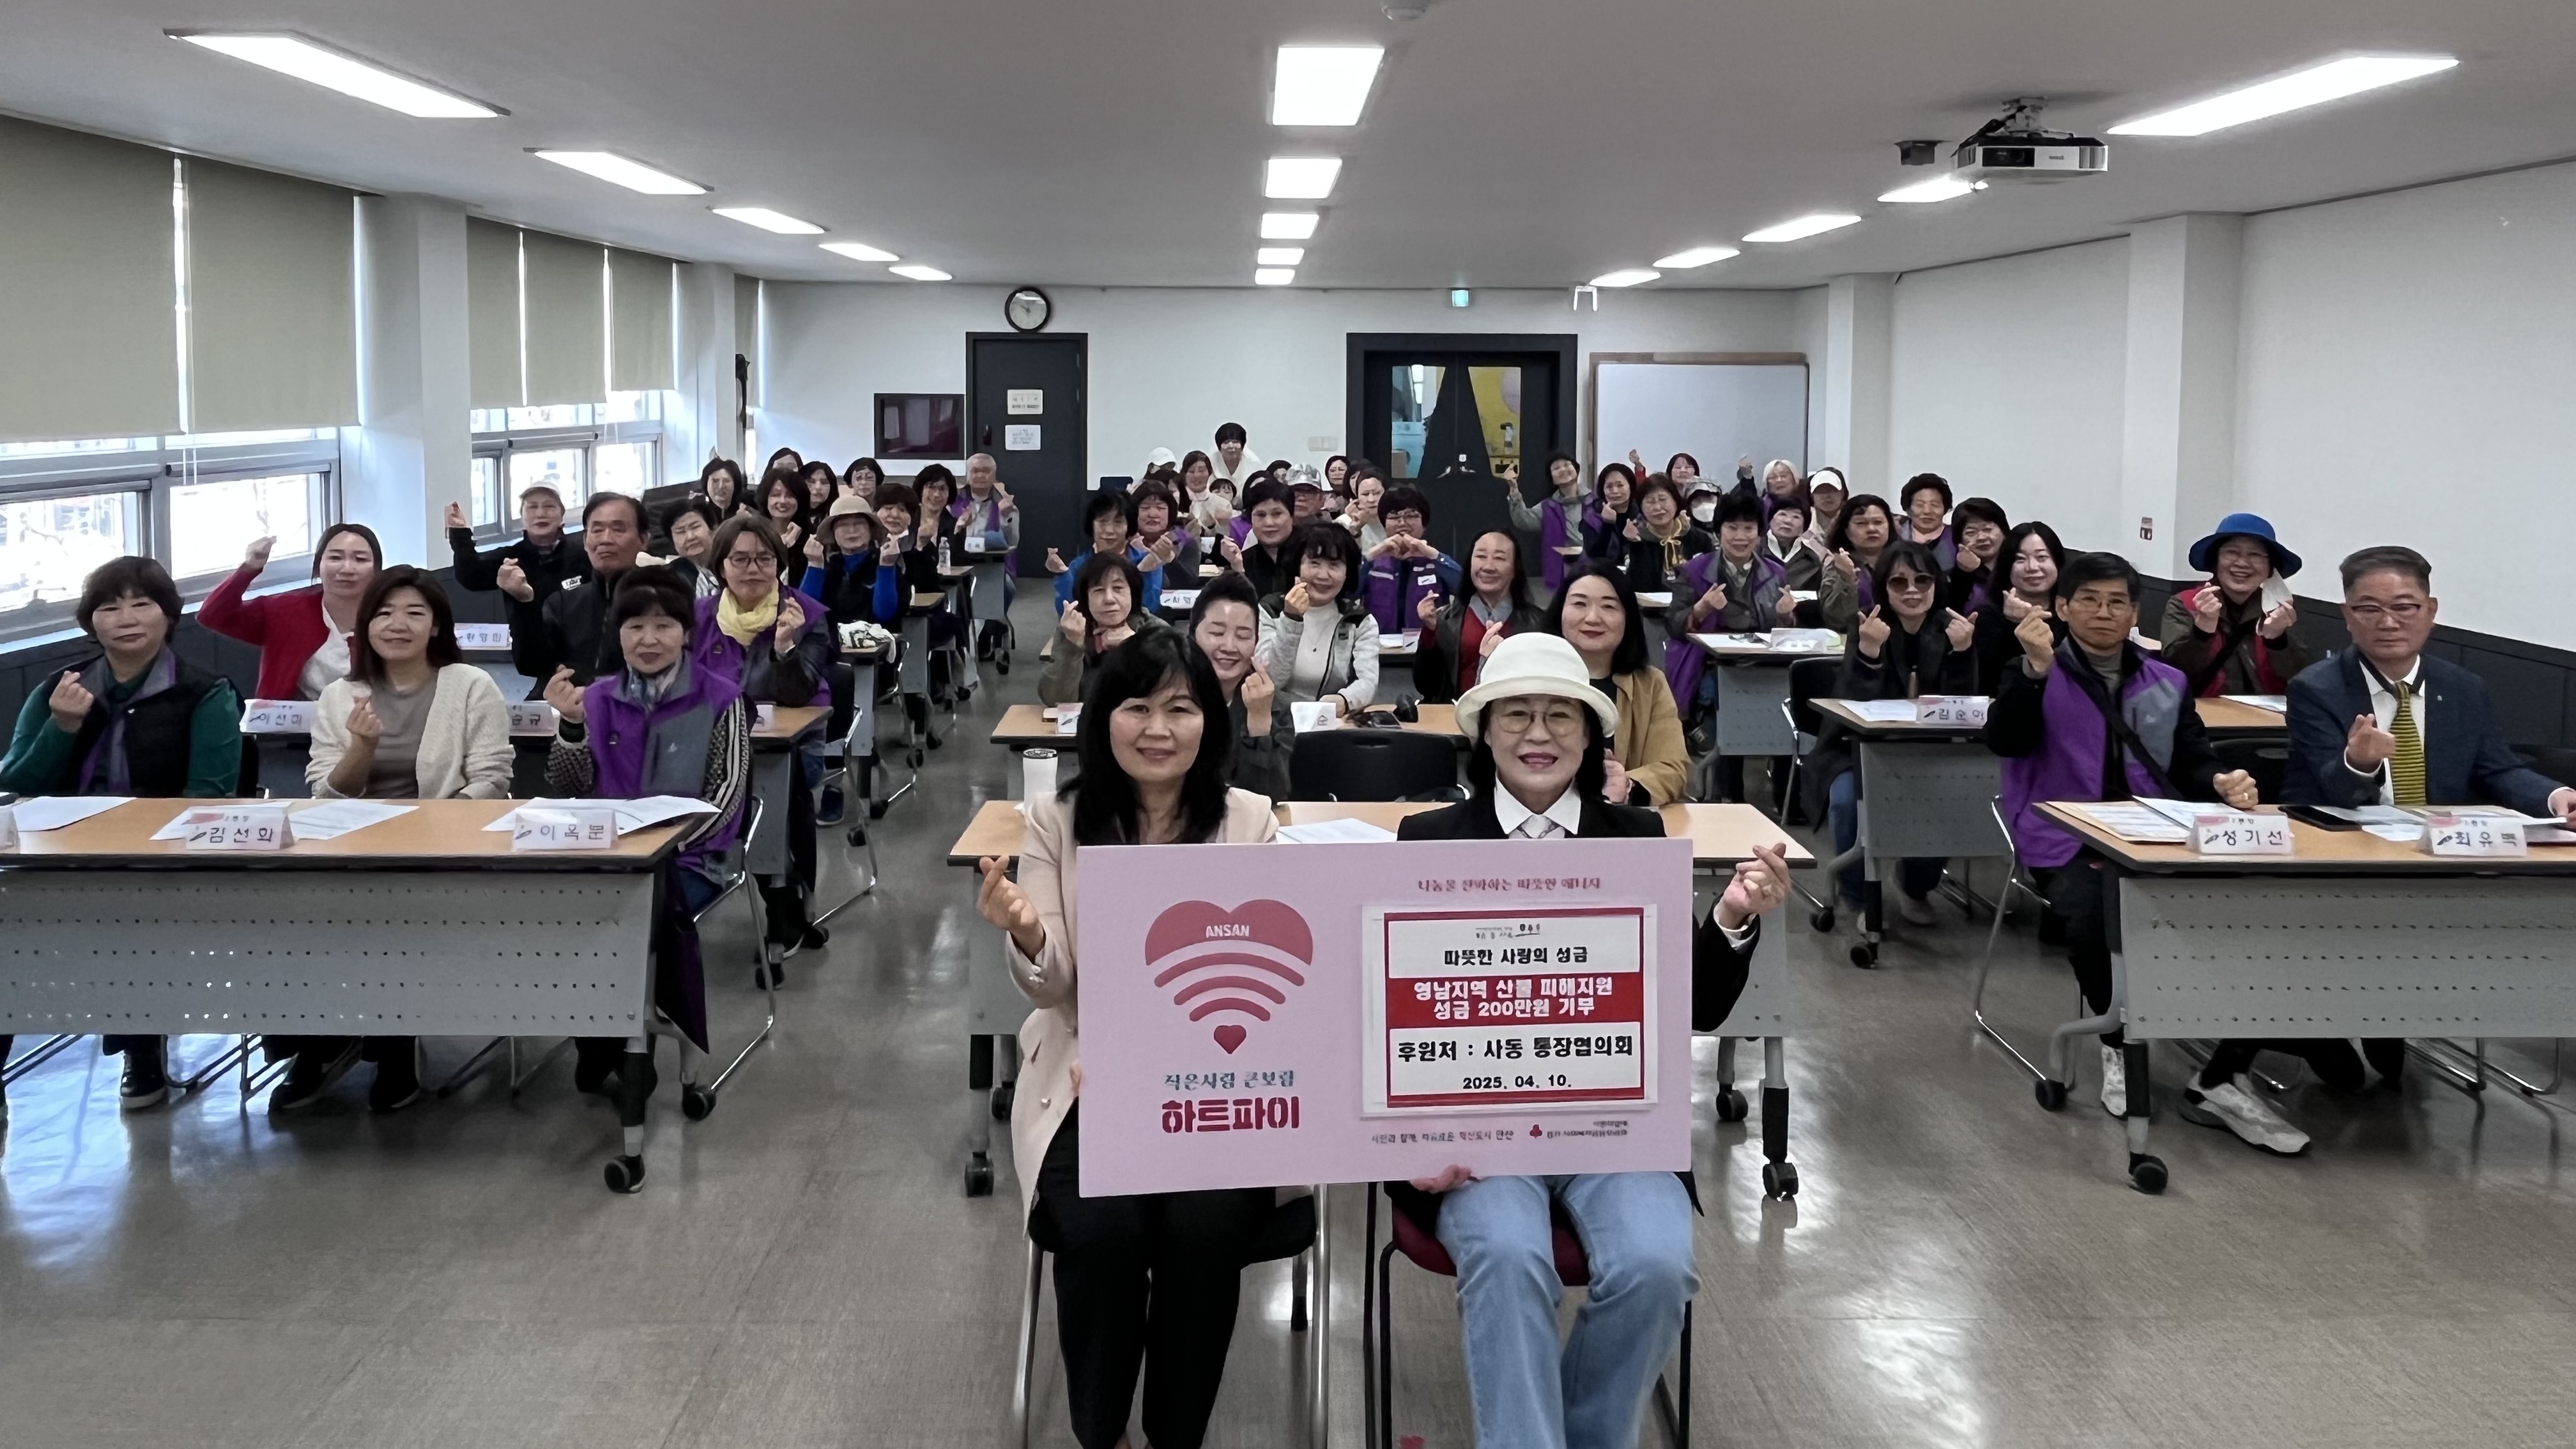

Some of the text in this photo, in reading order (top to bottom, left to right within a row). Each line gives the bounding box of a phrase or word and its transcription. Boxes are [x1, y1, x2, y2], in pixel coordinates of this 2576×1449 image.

[1205, 924, 1250, 938] ANSAN
[1444, 946, 1588, 966] 따뜻한 사랑의 성금
[1414, 979, 1487, 1000] 영남지역
[1540, 977, 1613, 997] 피해지원
[1434, 997, 1595, 1020] 성금 200만원 기부
[1483, 1038, 1523, 1059] 사동
[1533, 1035, 1633, 1058] 통장협의회
[1462, 1073, 1572, 1090] 2025. 04. 10.
[1162, 1096, 1300, 1133] 하트파이
